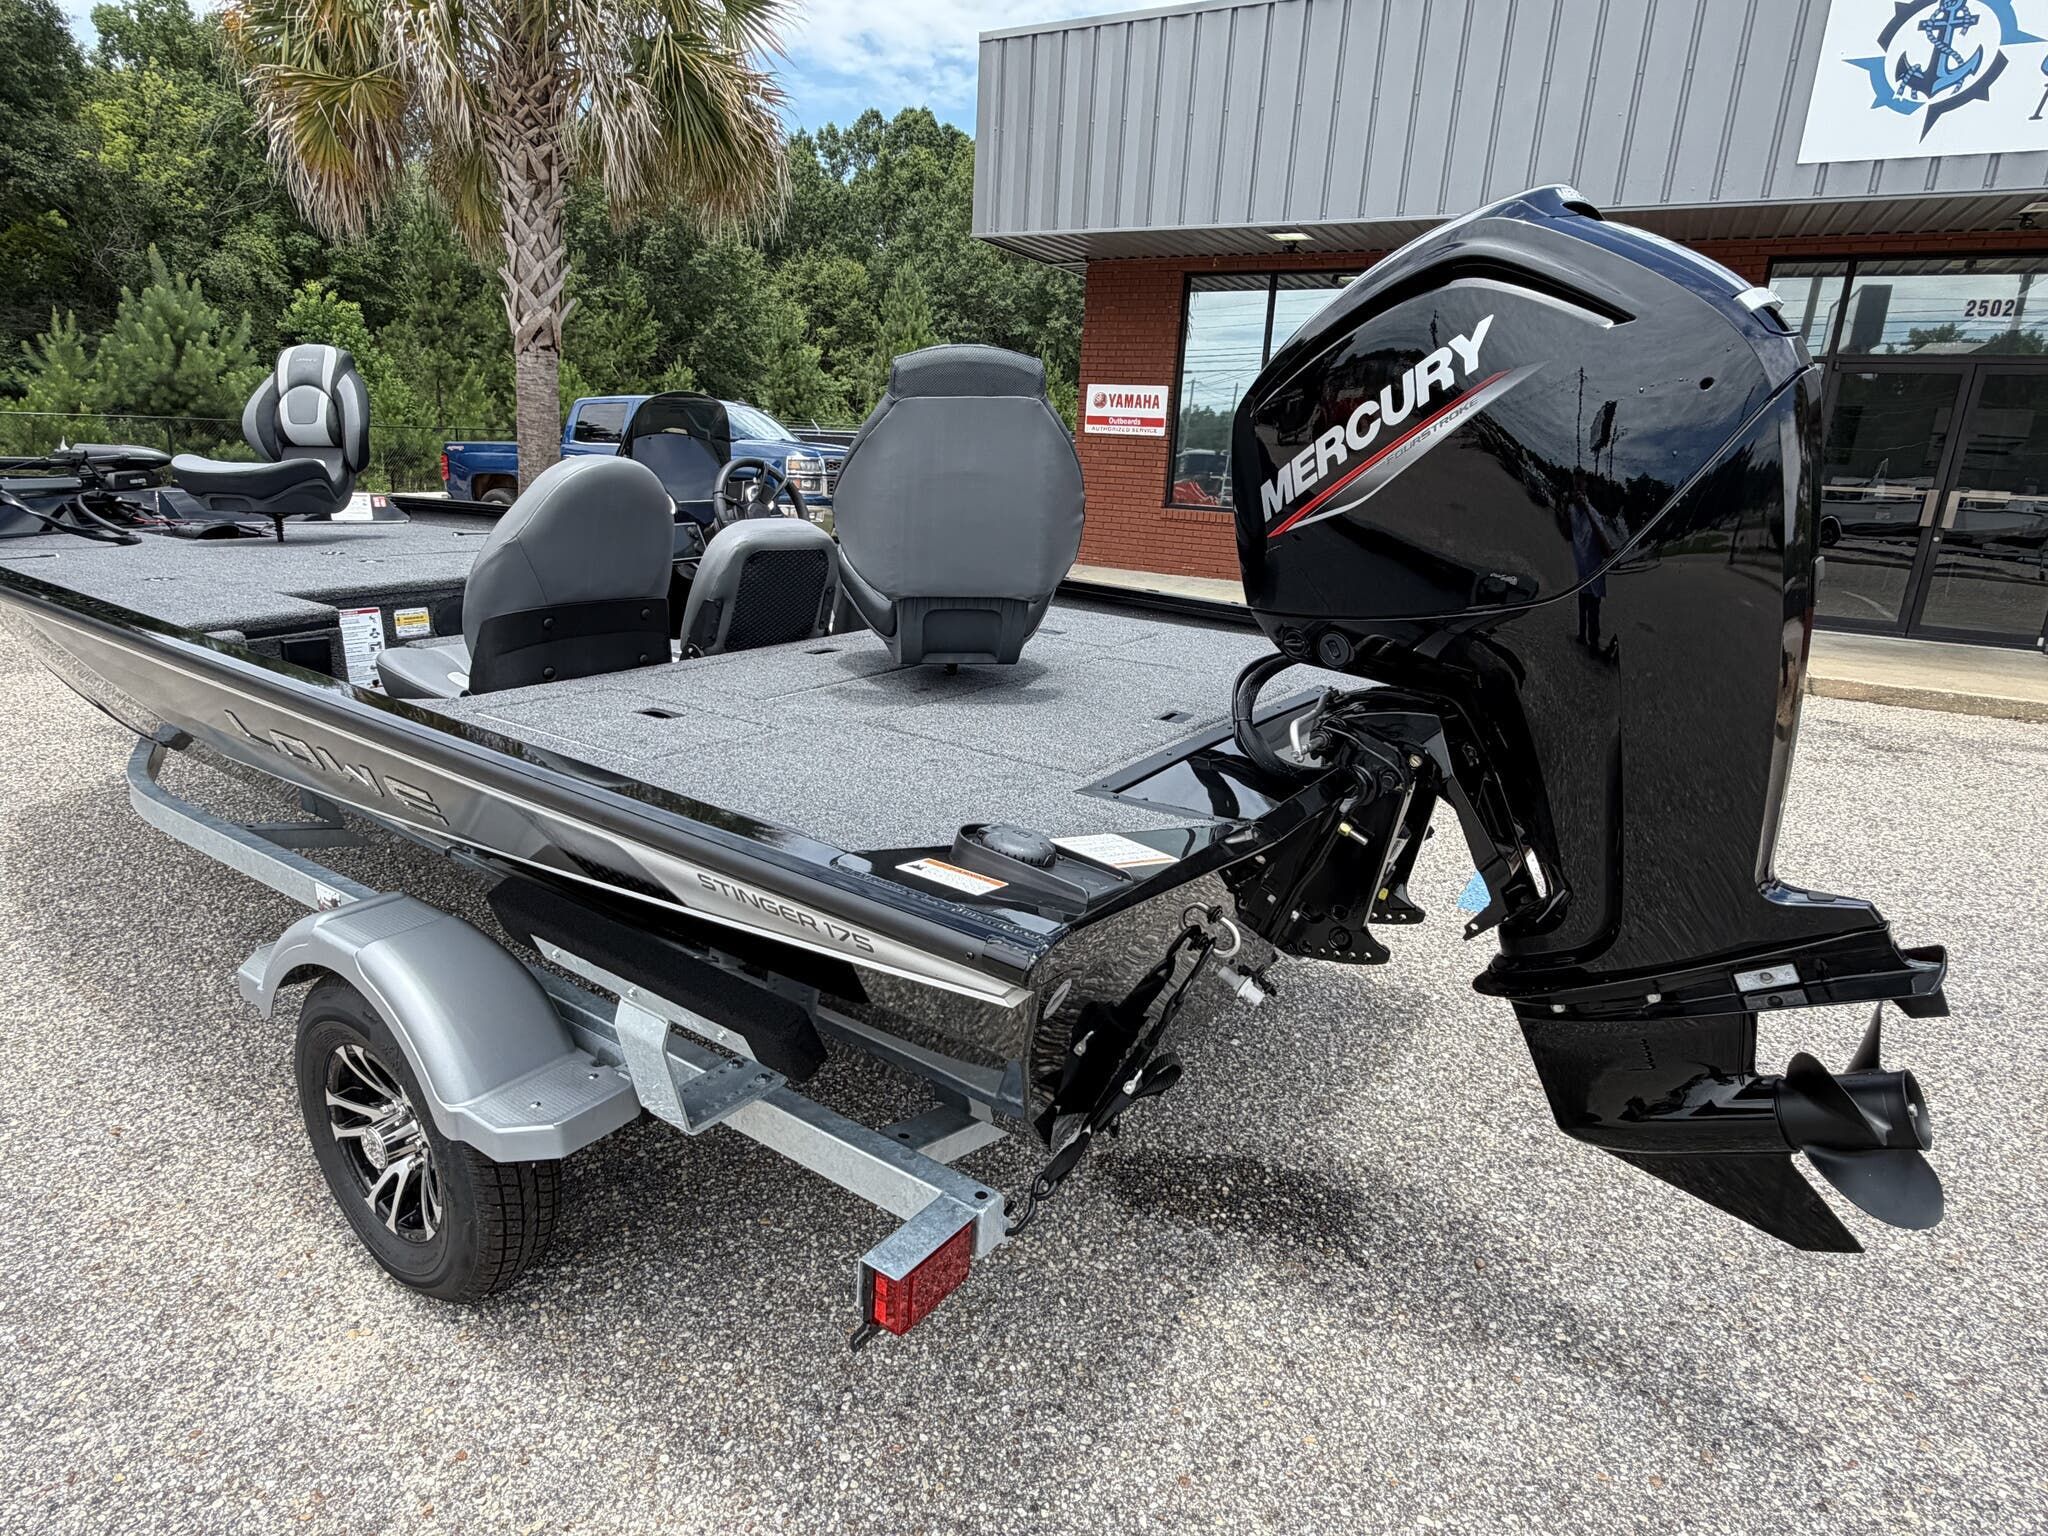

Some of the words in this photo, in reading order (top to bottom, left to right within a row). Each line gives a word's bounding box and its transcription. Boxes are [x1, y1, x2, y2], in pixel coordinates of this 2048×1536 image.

[1964, 299, 2015, 317] 2502
[1108, 393, 1160, 409] YAMAHA
[1108, 417, 1141, 425] Outboards
[1260, 313, 1495, 522] MERCURY
[1386, 398, 1480, 464] FOURSTROKE
[224, 709, 449, 826] LOWE
[697, 873, 820, 932] STINGER
[823, 921, 875, 953] 175
